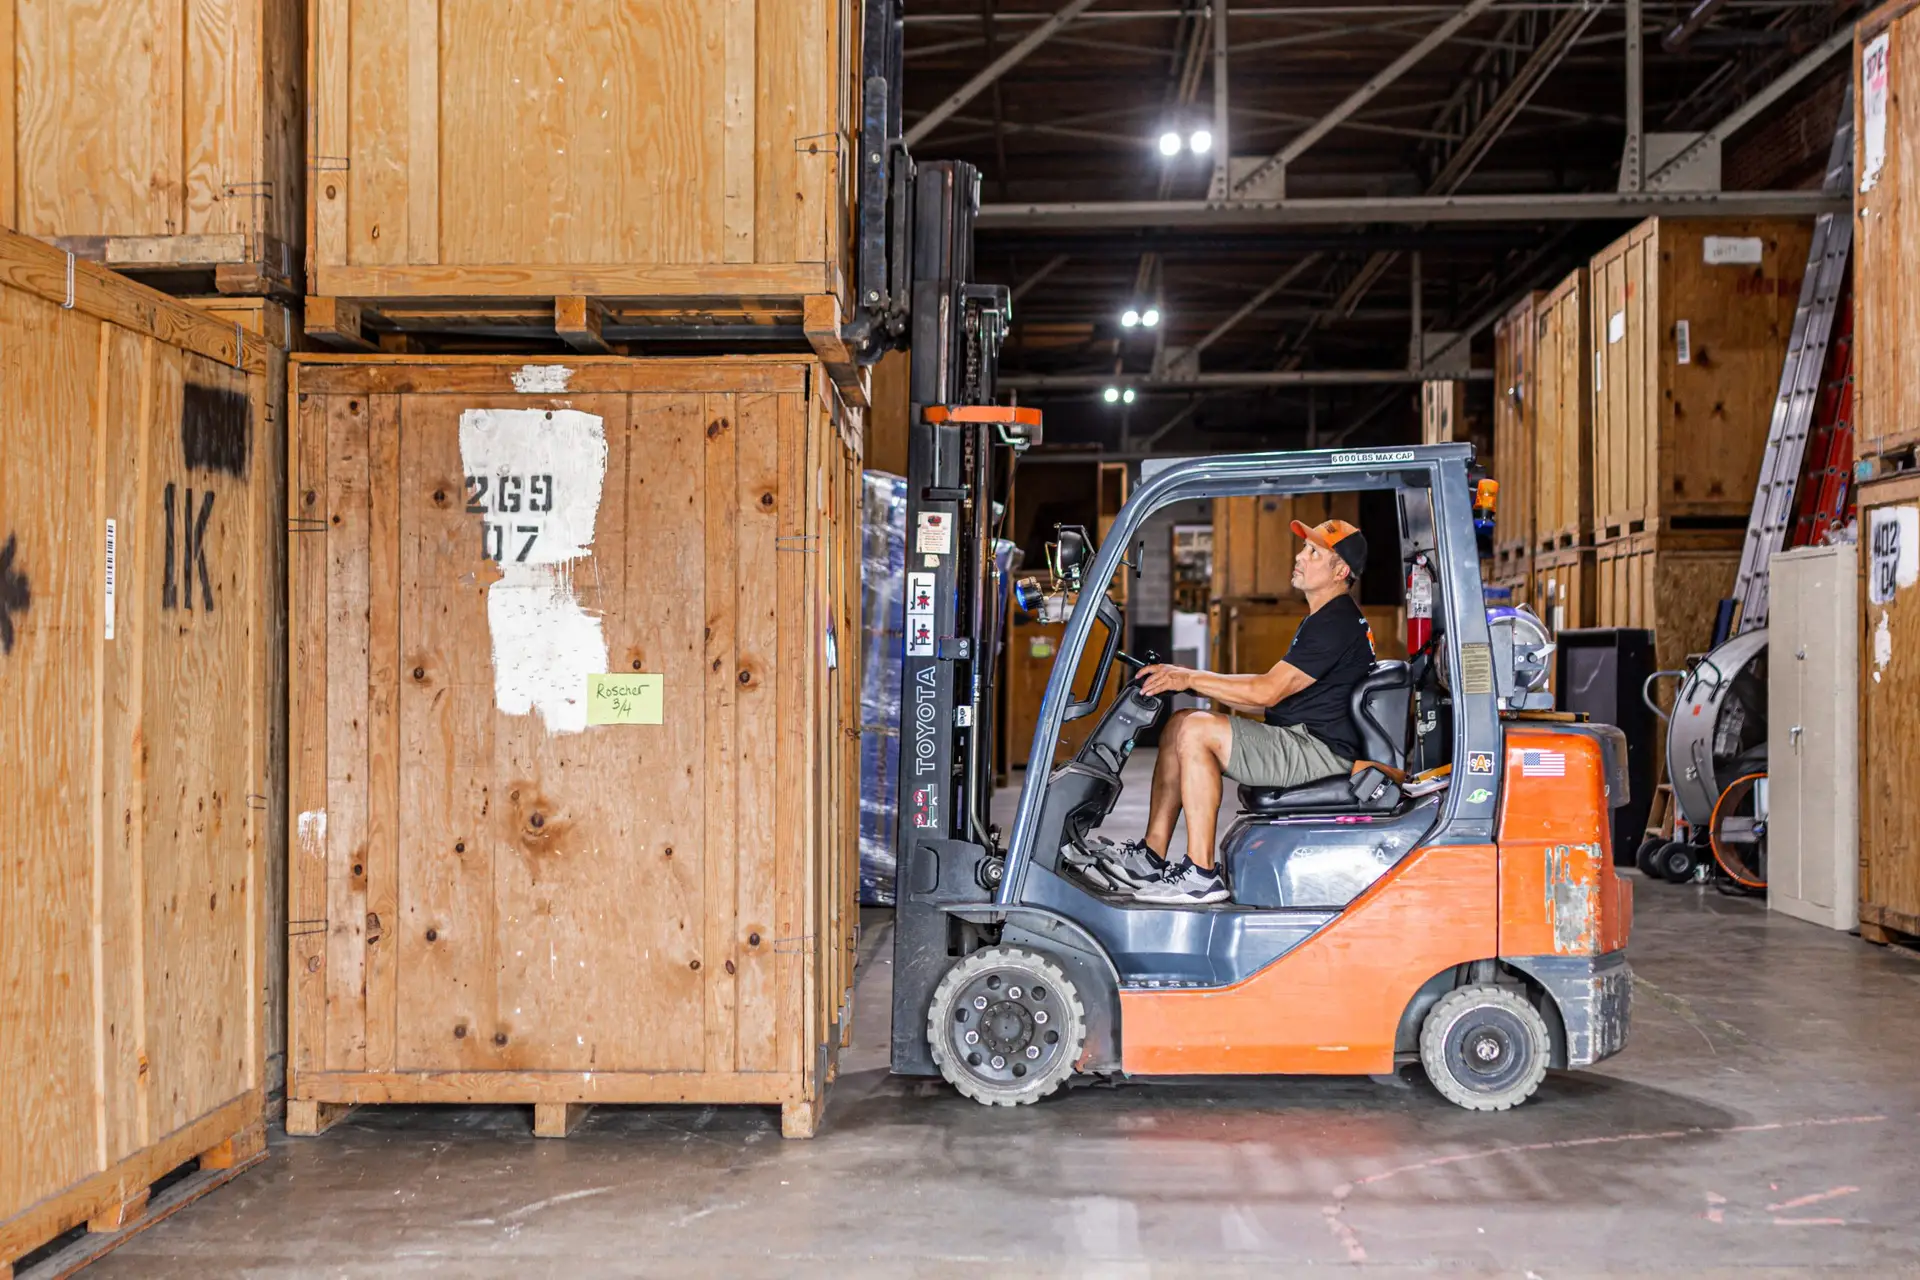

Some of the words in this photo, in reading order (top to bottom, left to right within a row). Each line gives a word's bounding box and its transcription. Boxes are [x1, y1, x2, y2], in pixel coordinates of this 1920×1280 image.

[1375, 453, 1394, 461] MAX
[1395, 452, 1413, 460] CAP
[1874, 520, 1898, 557] 402
[597, 683, 649, 699] Roscher
[612, 698, 632, 718] 3/4
[916, 666, 936, 775] TOYOTA
